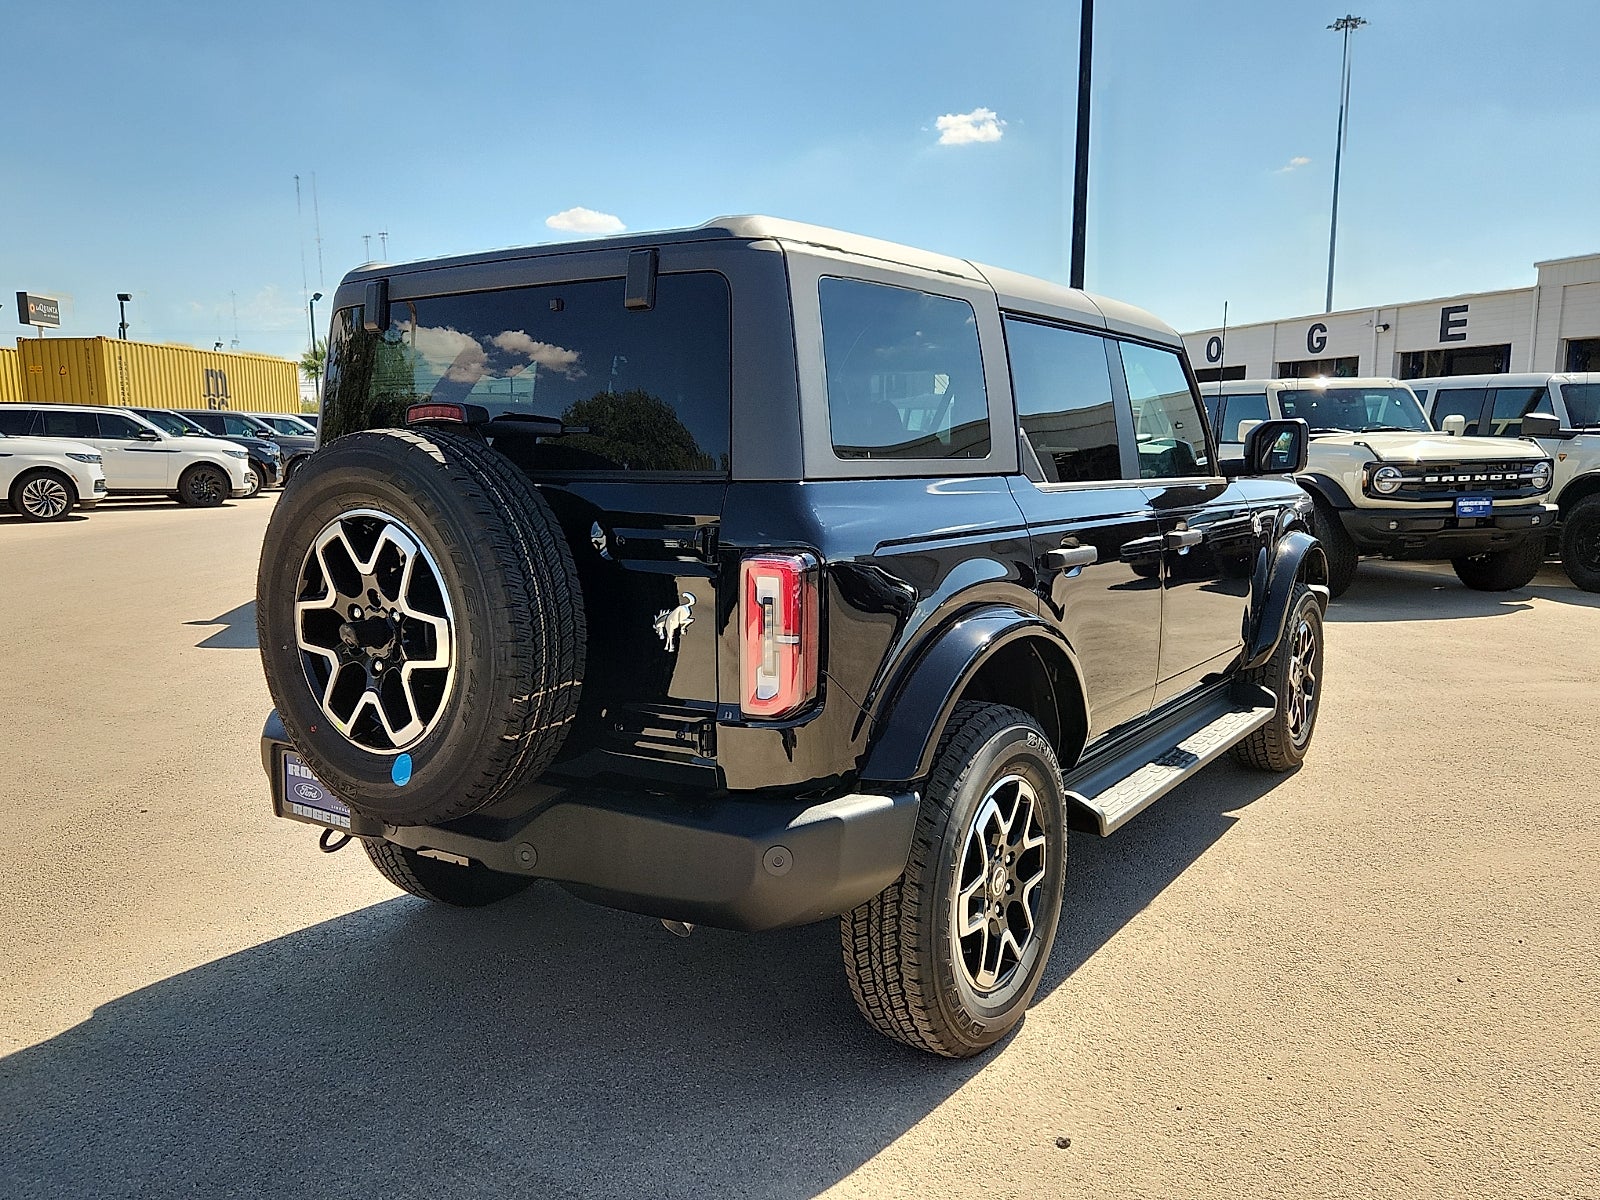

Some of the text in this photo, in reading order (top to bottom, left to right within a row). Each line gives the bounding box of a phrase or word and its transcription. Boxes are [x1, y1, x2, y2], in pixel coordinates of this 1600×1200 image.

[1306, 322, 1328, 354] G
[1439, 304, 1469, 343] E
[1424, 473, 1518, 483] BRONCO
[299, 783, 319, 799] Ford
[292, 804, 351, 829] ROGERS
